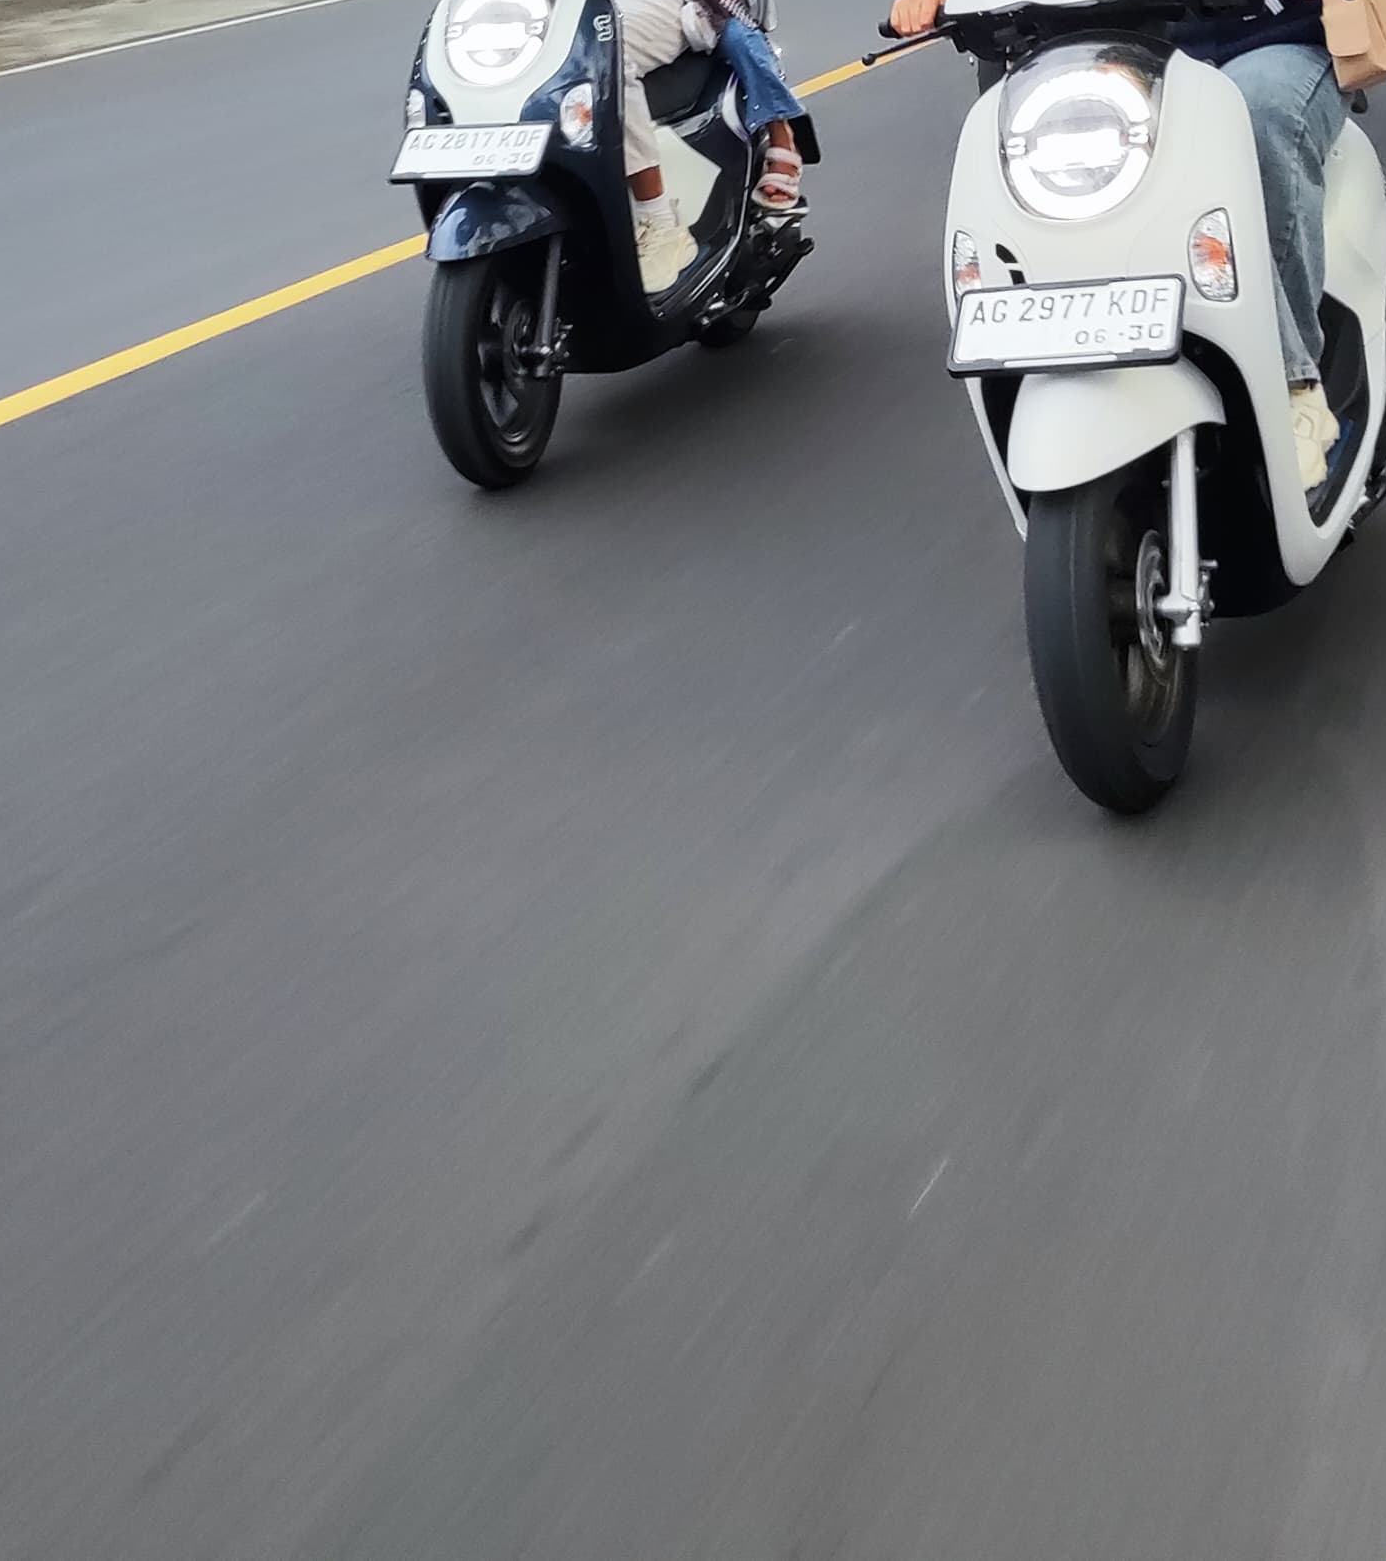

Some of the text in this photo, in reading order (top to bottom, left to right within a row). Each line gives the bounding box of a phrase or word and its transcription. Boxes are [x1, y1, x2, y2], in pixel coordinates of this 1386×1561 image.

[408, 128, 544, 151] AG 2817 KDF
[970, 287, 1170, 326] AG 2977 KDF
